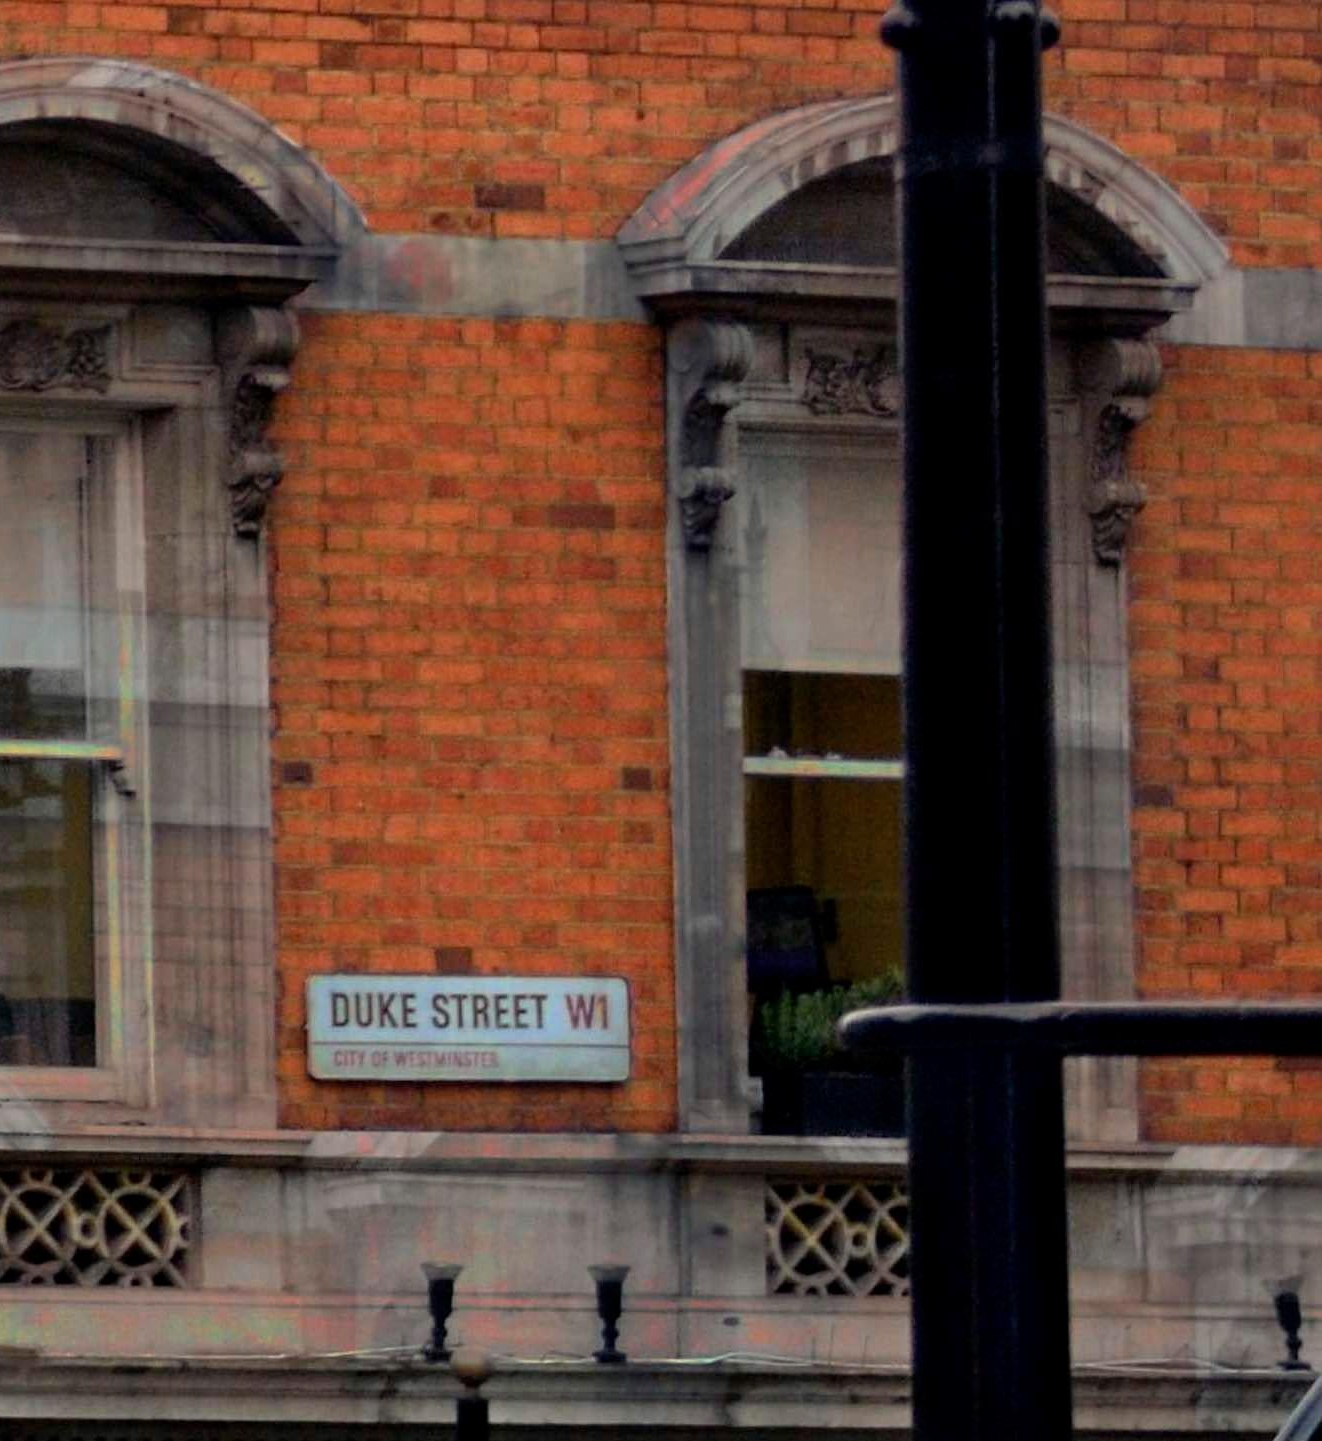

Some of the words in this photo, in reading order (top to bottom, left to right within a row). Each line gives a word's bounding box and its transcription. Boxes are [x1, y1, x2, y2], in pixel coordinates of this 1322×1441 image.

[330, 992, 417, 1029] DUKE
[431, 993, 547, 1030] STREET
[565, 993, 609, 1030] W1
[333, 1049, 365, 1068] CITY
[370, 1050, 387, 1069] OF
[393, 1050, 499, 1069] WESTMINSTER
